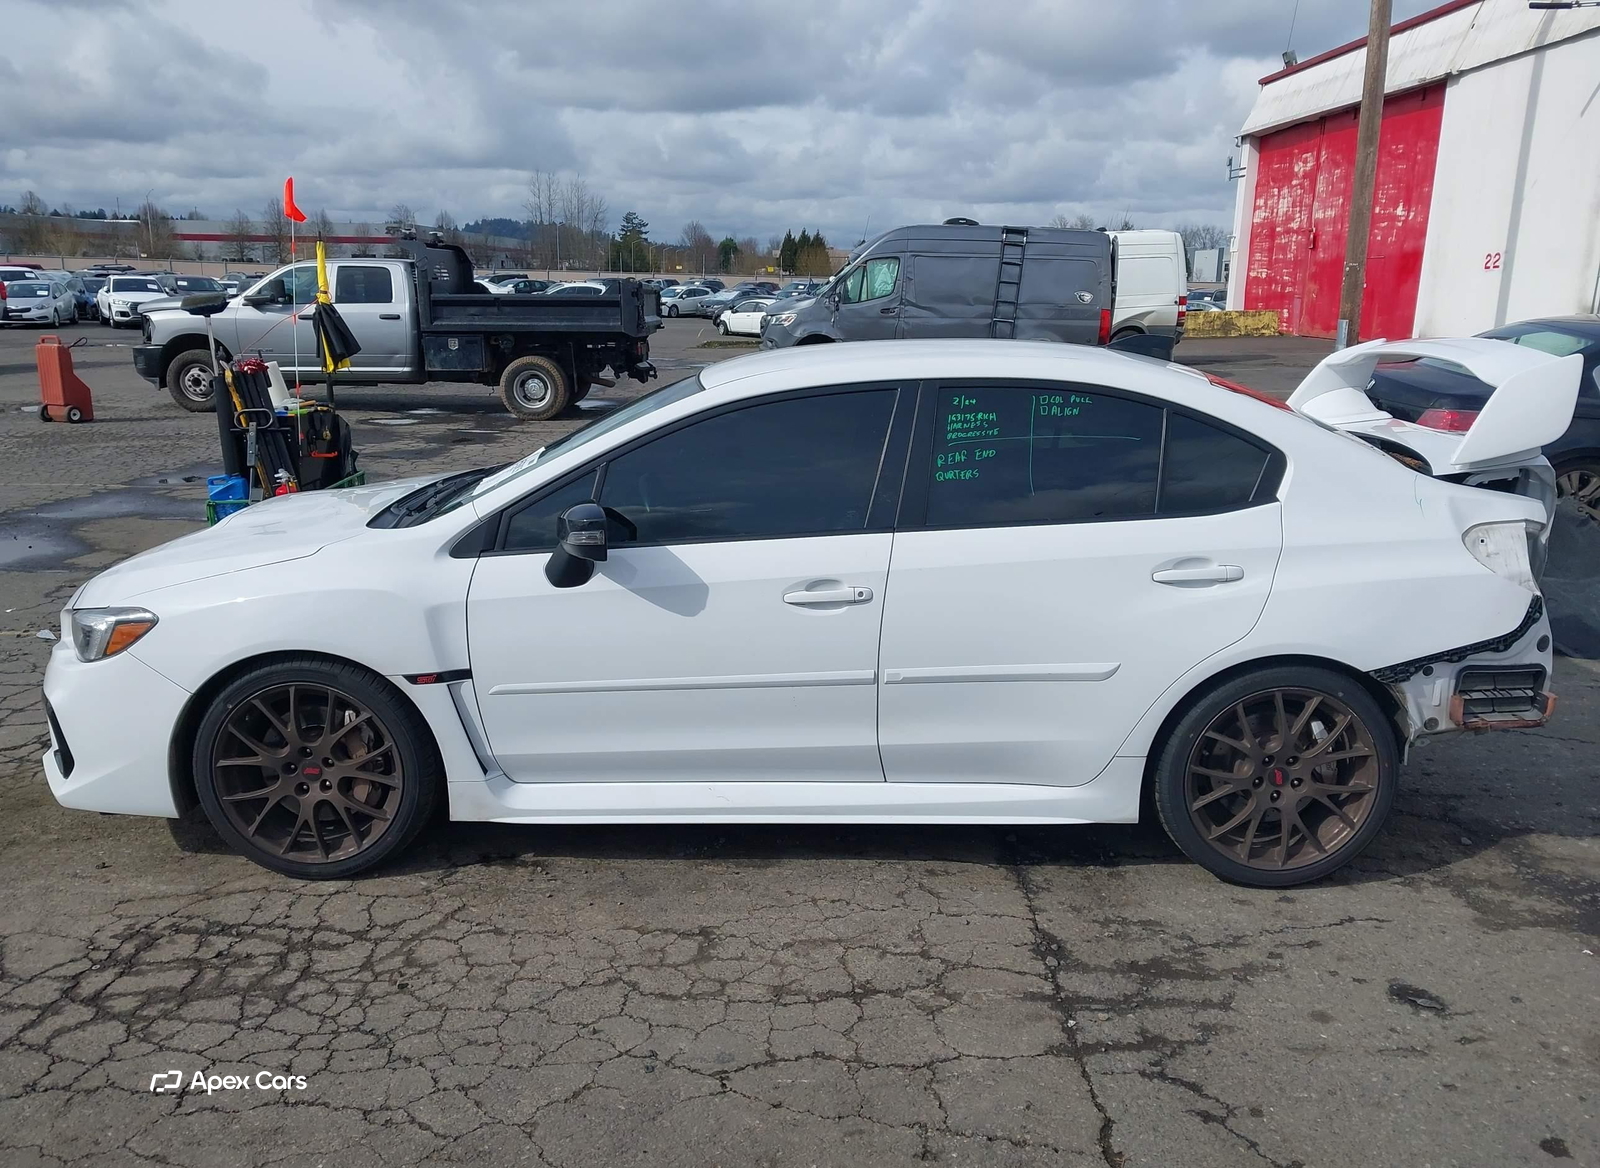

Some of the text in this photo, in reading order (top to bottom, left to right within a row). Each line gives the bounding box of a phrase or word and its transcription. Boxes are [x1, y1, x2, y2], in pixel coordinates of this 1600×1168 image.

[1484, 252, 1501, 270] 22
[1051, 405, 1080, 416] ALIGN
[937, 448, 996, 467] REAR END
